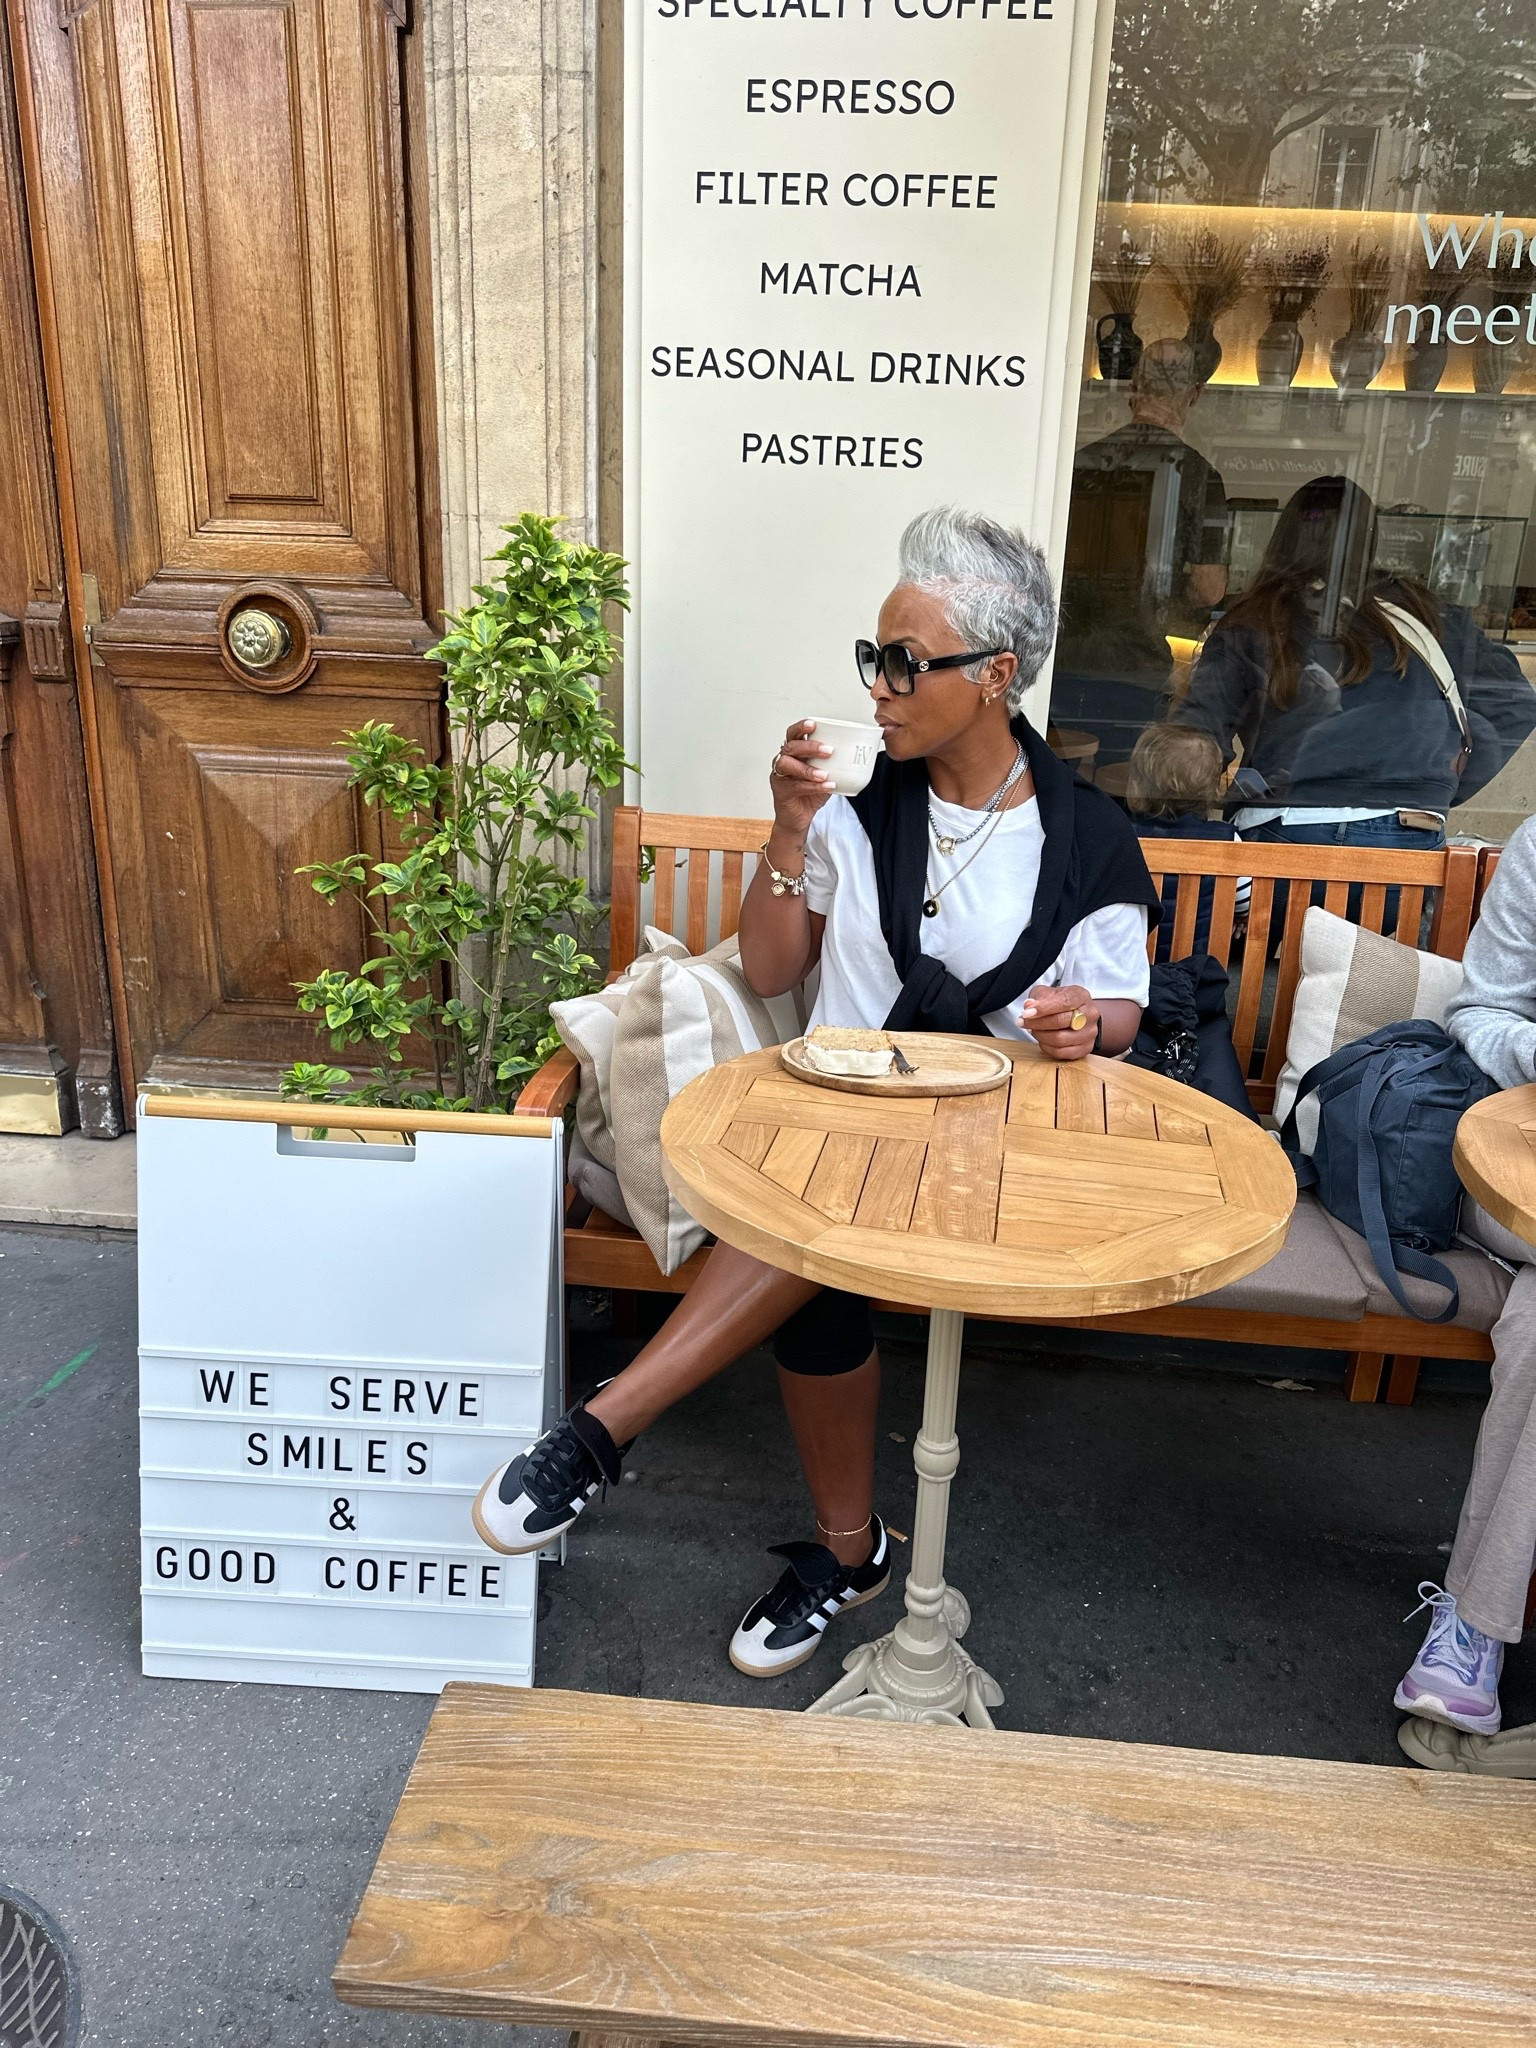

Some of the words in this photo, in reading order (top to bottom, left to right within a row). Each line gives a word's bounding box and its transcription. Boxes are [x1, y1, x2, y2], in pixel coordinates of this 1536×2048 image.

[894, 0, 1054, 20] COFFEE
[747, 78, 955, 115] ESPRESSO
[696, 171, 829, 206] FILTER
[843, 173, 998, 209] COFFEE
[1417, 210, 1536, 270] Wh
[760, 262, 922, 297] MATCHA
[651, 346, 855, 382] SEASONAL
[870, 351, 1026, 387] DRINKS
[742, 432, 924, 469] PASTRIES
[199, 1368, 270, 1407] WE
[330, 1376, 479, 1417] SERVE
[247, 1432, 428, 1476] SMILES
[329, 1497, 357, 1532] &
[156, 1546, 276, 1584] GOOD
[325, 1555, 502, 1599] COFFEE
